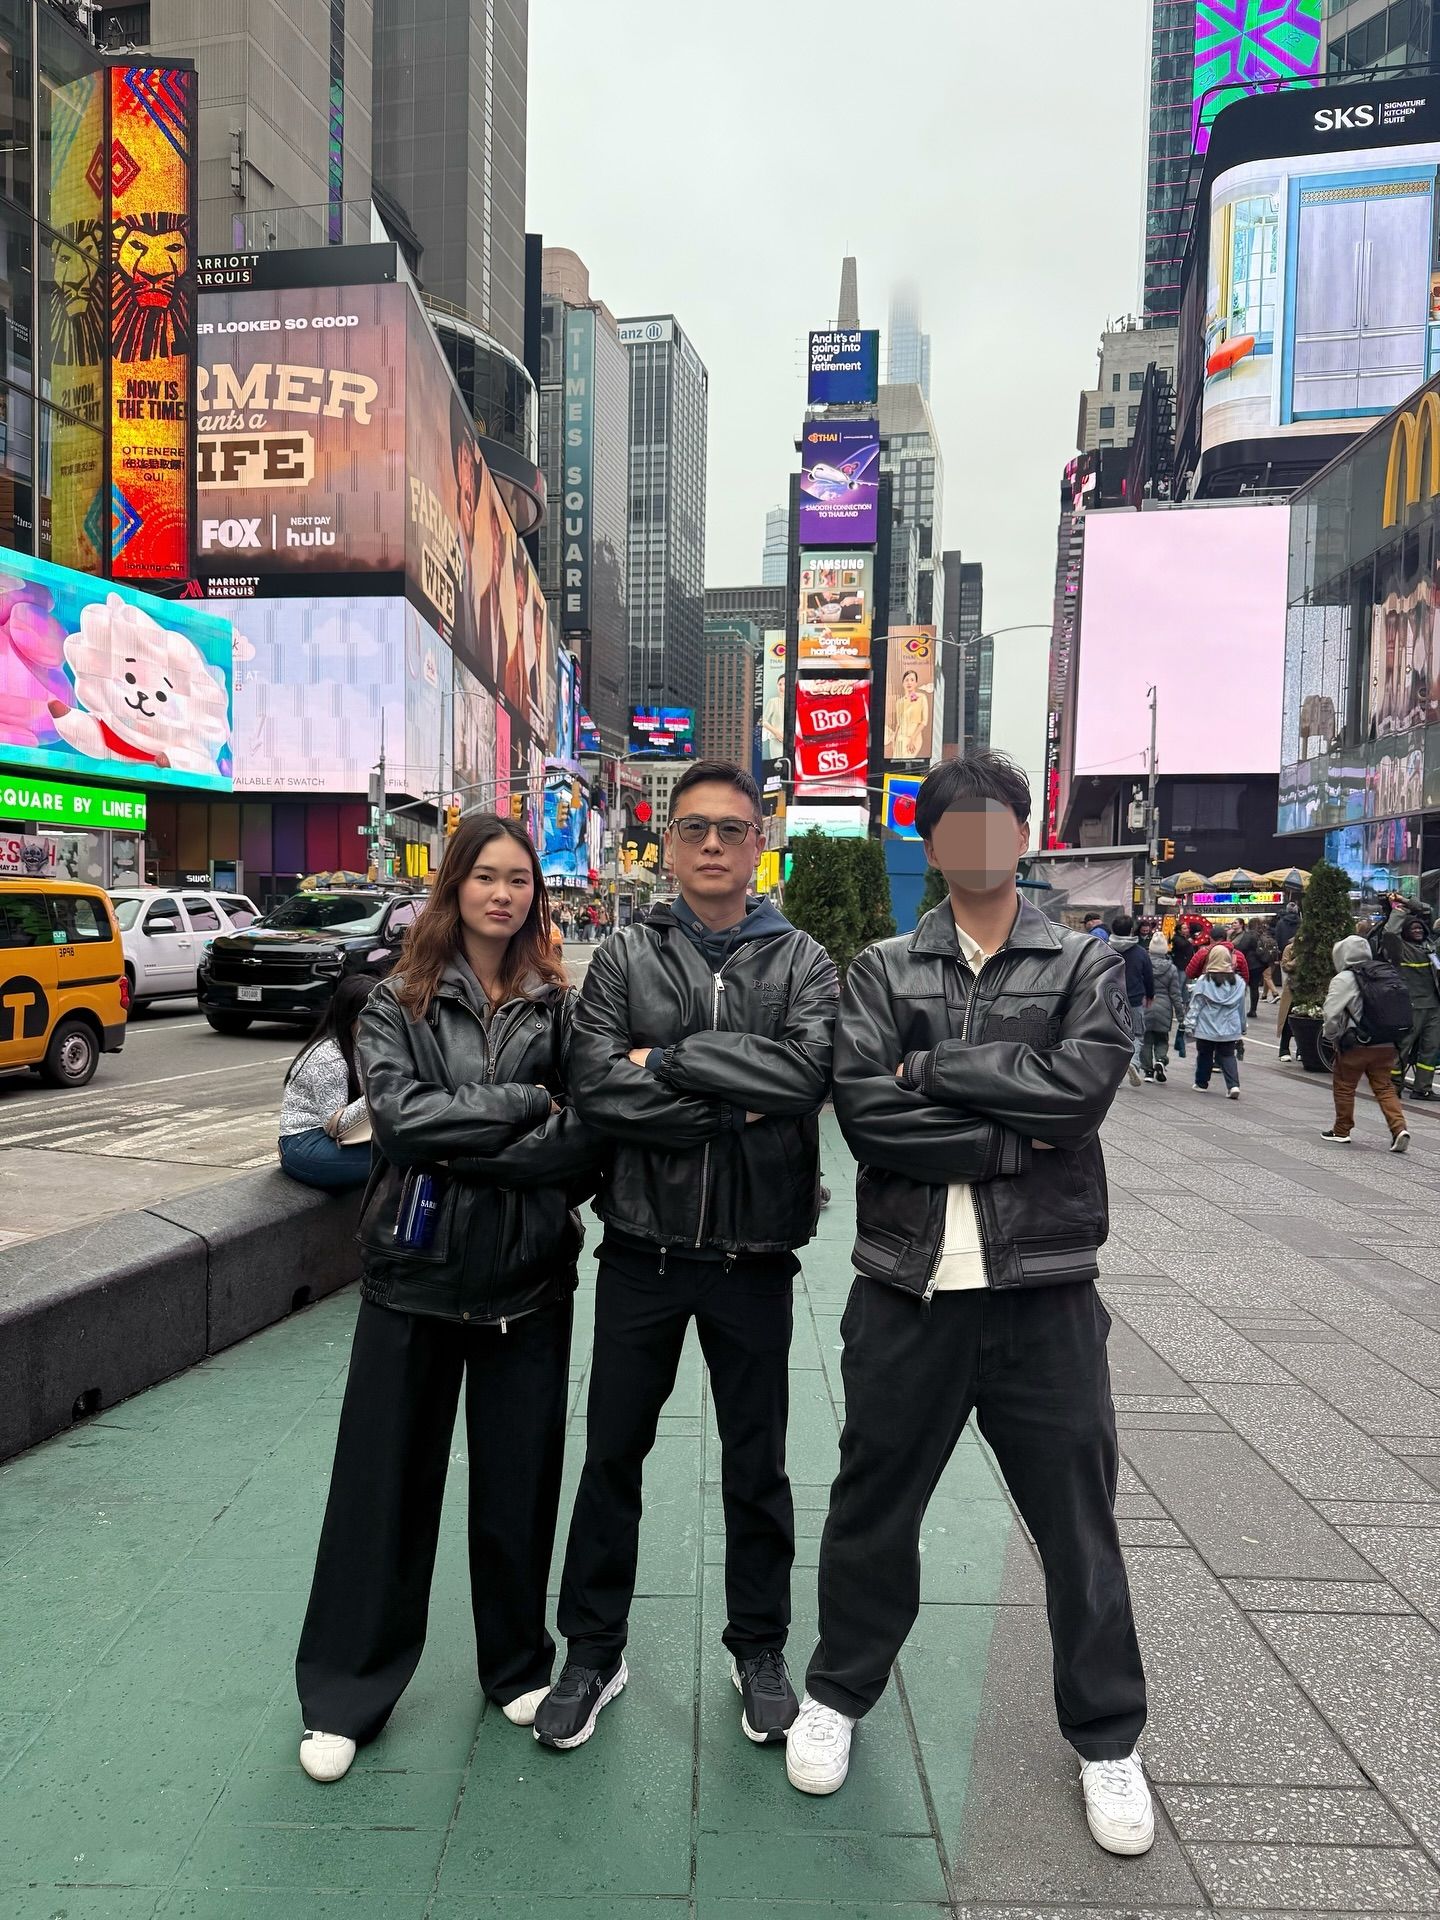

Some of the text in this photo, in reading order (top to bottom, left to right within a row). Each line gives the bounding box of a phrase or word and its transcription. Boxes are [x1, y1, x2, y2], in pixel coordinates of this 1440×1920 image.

[1384, 99, 1426, 110] SIGNATURE
[1314, 104, 1374, 131] SKS
[1383, 108, 1416, 117] KITCHEN
[1383, 116, 1405, 124] SUITE
[217, 319, 281, 334] LOOKED
[284, 318, 308, 330] SO
[311, 315, 359, 328] GOOD
[812, 332, 861, 343] And it's all
[811, 342, 860, 354] going into
[811, 354, 834, 363] your
[811, 361, 861, 371] retirement
[127, 380, 179, 400] NOW IS
[117, 400, 145, 420] THE
[249, 413, 267, 430] a
[122, 446, 185, 457] OTTENERE
[565, 328, 586, 612] TIMES SQUARE
[143, 472, 164, 482] QUI
[290, 516, 331, 526] NEXT DAY
[202, 518, 262, 549] FOX
[286, 527, 336, 547] hulu
[810, 559, 864, 569] SAMSUNG
[208, 577, 260, 586] MARRIOTT
[424, 550, 454, 620] WIFE
[208, 587, 254, 596] MARQUIS
[819, 637, 851, 645] Control
[810, 646, 858, 656] hands-free
[811, 710, 851, 730] Bro
[819, 750, 848, 771] Sis
[274, 778, 285, 786] AT
[287, 778, 325, 786] SWATCH
[73, 796, 93, 813] BY
[102, 800, 132, 819] LINE
